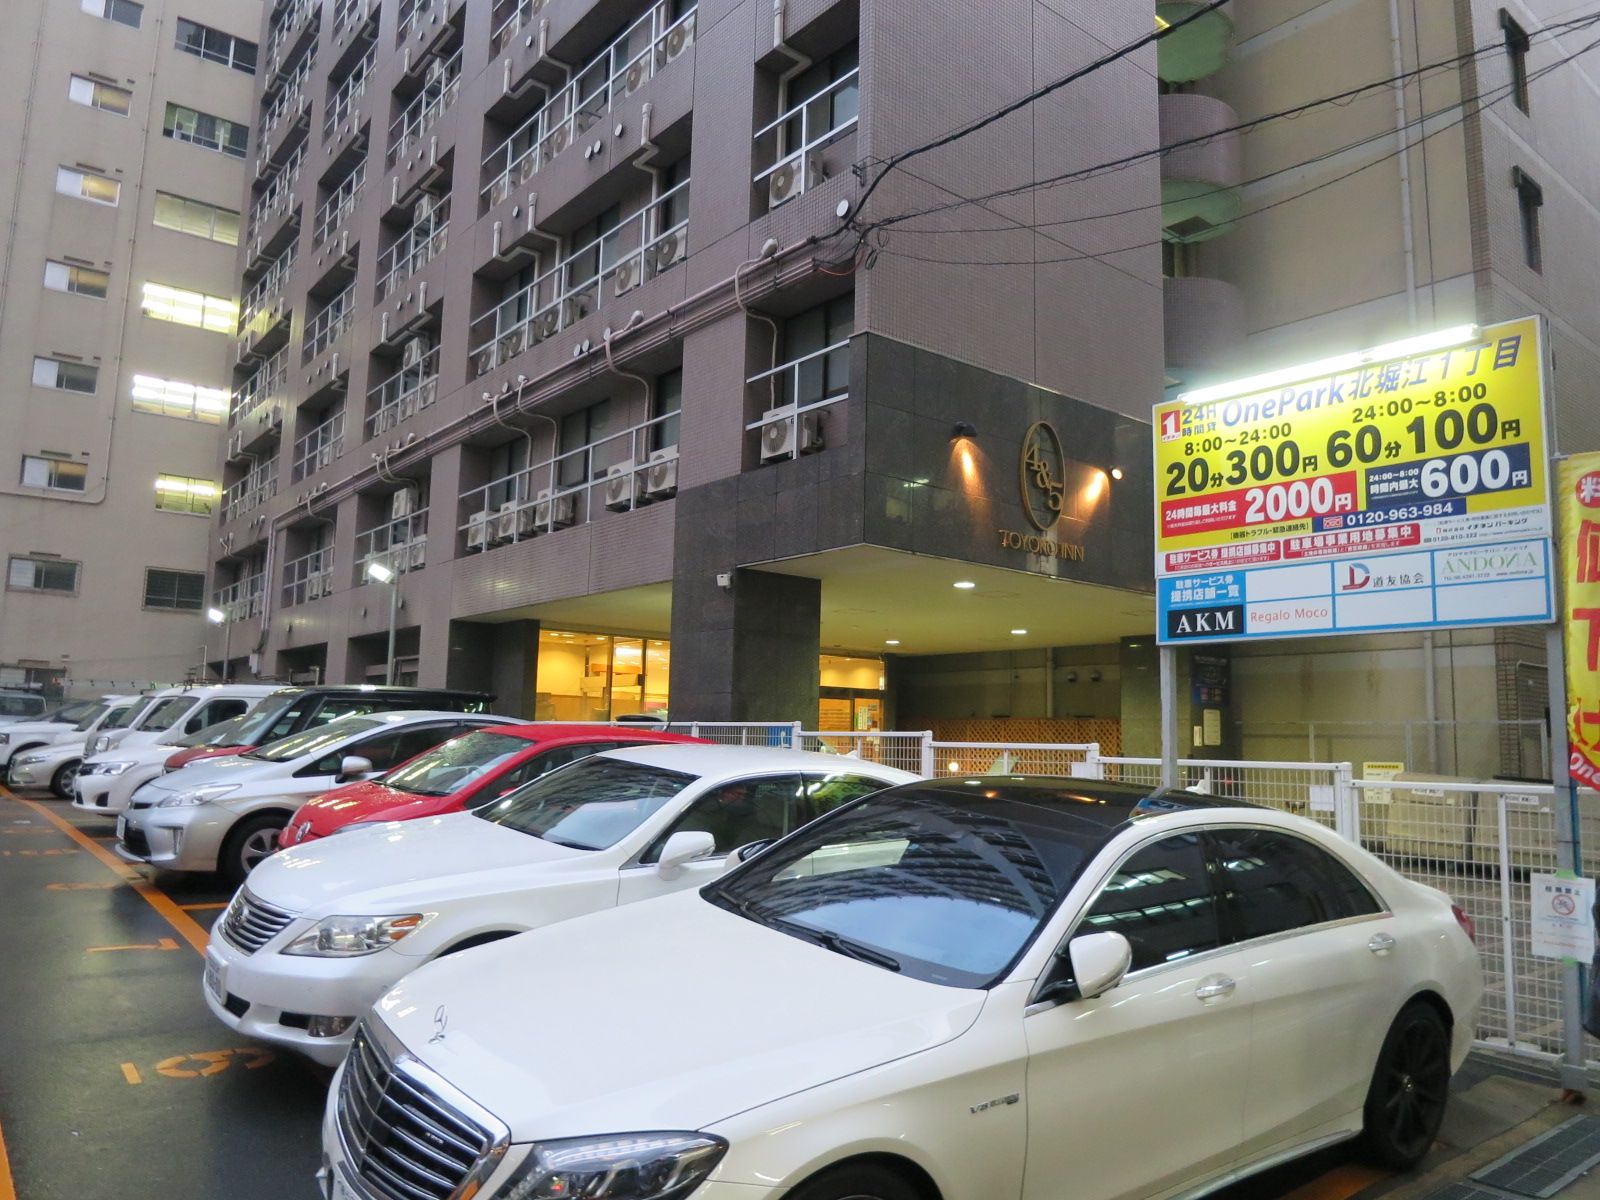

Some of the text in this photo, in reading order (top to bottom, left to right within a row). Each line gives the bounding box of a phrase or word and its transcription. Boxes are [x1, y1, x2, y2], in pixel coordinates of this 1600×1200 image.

[1222, 375, 1344, 427] OnePark
[1420, 449, 1528, 498] 600円
[1245, 477, 1352, 523] 2000円
[1346, 501, 1454, 526] 0120-963-984
[1060, 541, 1084, 561] INN
[1373, 572, 1425, 588] 道友協会
[1176, 610, 1235, 634] AKM
[1250, 608, 1329, 624] Regalo Moco
